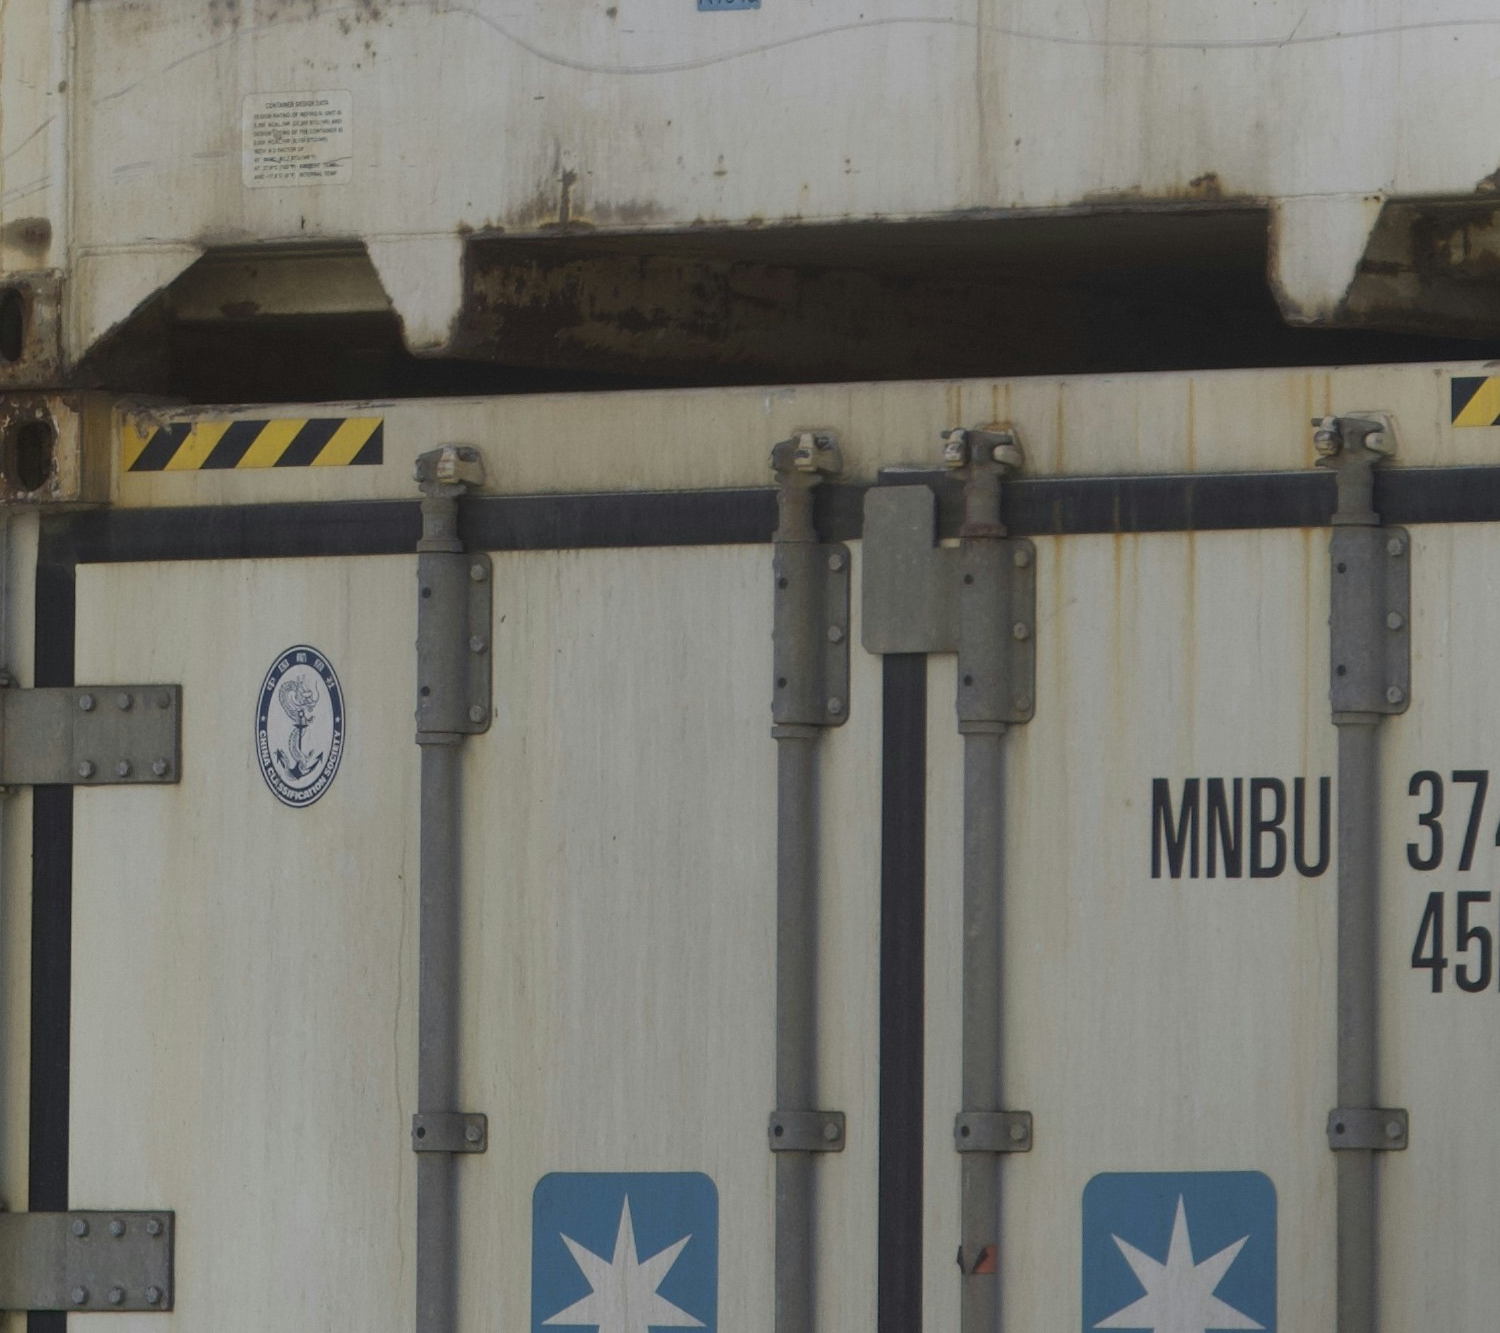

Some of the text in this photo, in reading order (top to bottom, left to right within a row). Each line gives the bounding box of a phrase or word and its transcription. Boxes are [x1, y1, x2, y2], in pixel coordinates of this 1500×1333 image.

[258, 730, 341, 800] CHINA CLASSIFICATION SOCIETY
[1149, 775, 1332, 882] MNBU
